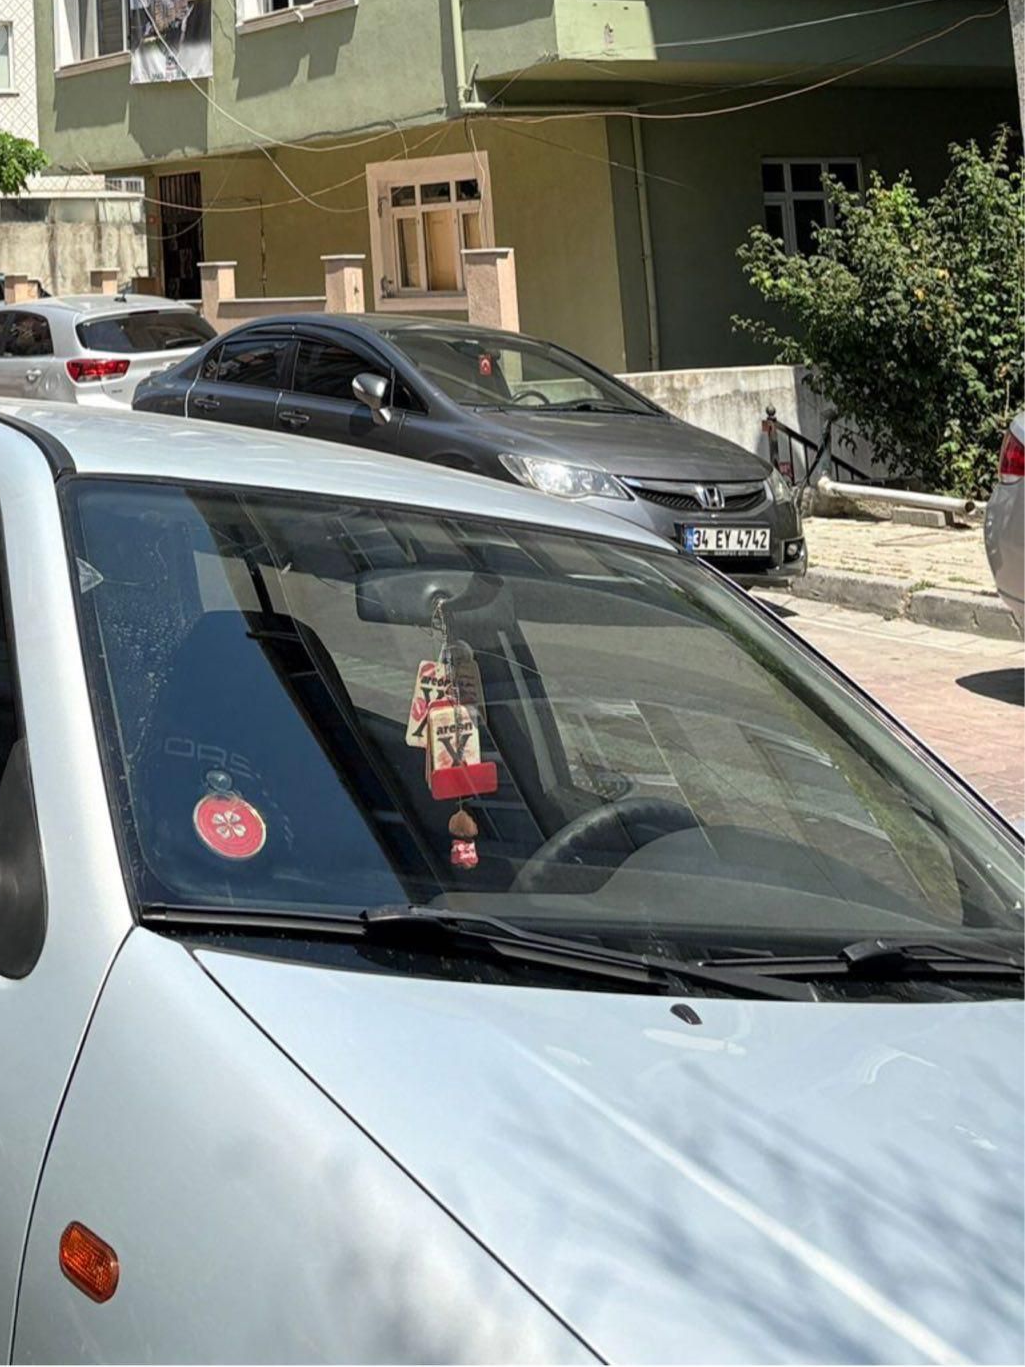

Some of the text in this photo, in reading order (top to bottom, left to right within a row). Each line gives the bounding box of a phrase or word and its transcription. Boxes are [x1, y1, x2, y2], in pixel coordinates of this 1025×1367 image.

[693, 529, 767, 549] 34 EY 4742
